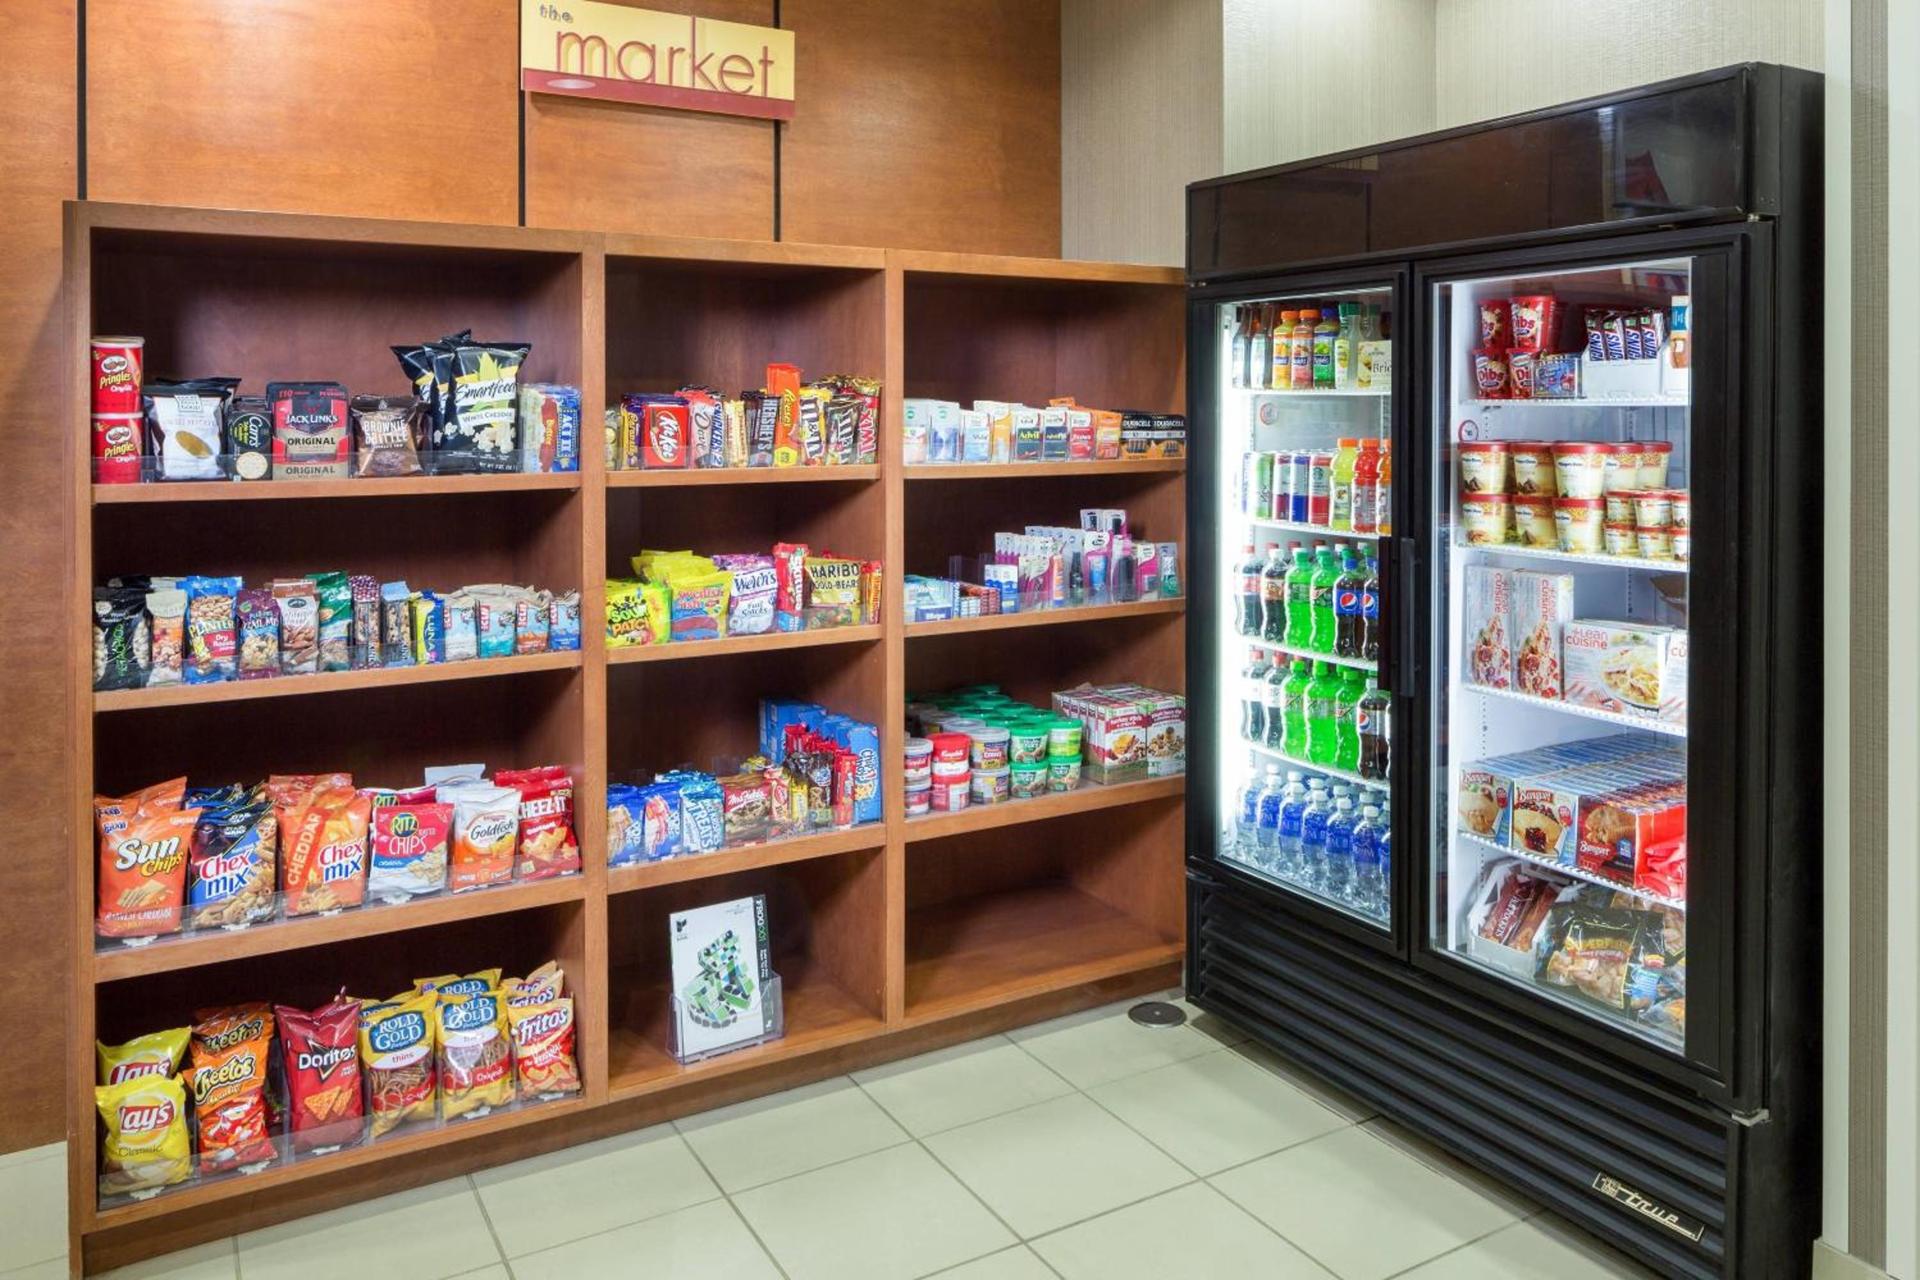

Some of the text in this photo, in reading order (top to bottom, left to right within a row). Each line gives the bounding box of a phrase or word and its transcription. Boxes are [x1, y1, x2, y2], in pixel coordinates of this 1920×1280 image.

[540, 5, 573, 22] the
[557, 15, 775, 97] market
[100, 371, 132, 389] Pringles
[1478, 366, 1504, 381] Dibs
[286, 414, 309, 425] JACK
[364, 419, 405, 433] BROWNIE
[561, 415, 572, 436] ACT
[711, 403, 725, 452] SNICKERS
[287, 437, 336, 446] ORIGINAL
[694, 410, 711, 452] Dove
[857, 411, 876, 456] TWIX
[1019, 431, 1039, 440] Advil
[104, 441, 136, 461] Pringles
[286, 466, 335, 475] ORIGINAL
[734, 571, 777, 592] Welch's
[811, 563, 860, 579] HARIBO
[611, 605, 648, 623] SOUR
[425, 615, 435, 652] LUNA
[1566, 636, 1608, 650] cuisine
[392, 816, 417, 834] RITZ
[470, 819, 514, 840] Goldfish
[687, 800, 713, 849] TREATS
[115, 836, 180, 871] Sun
[288, 813, 322, 885] CHEDDAR
[319, 842, 363, 866] Chex
[389, 835, 427, 855] CHIPS
[141, 851, 183, 877] Chips
[201, 850, 250, 880] Chex
[324, 855, 363, 881] mix
[207, 866, 250, 897] mix
[380, 1013, 418, 1033] ROLD
[449, 1006, 493, 1029] GOLD
[517, 1007, 567, 1045] Fritos
[376, 1024, 421, 1050] GOLD
[299, 1044, 356, 1069] Doritos
[195, 1056, 254, 1102] Cheetos
